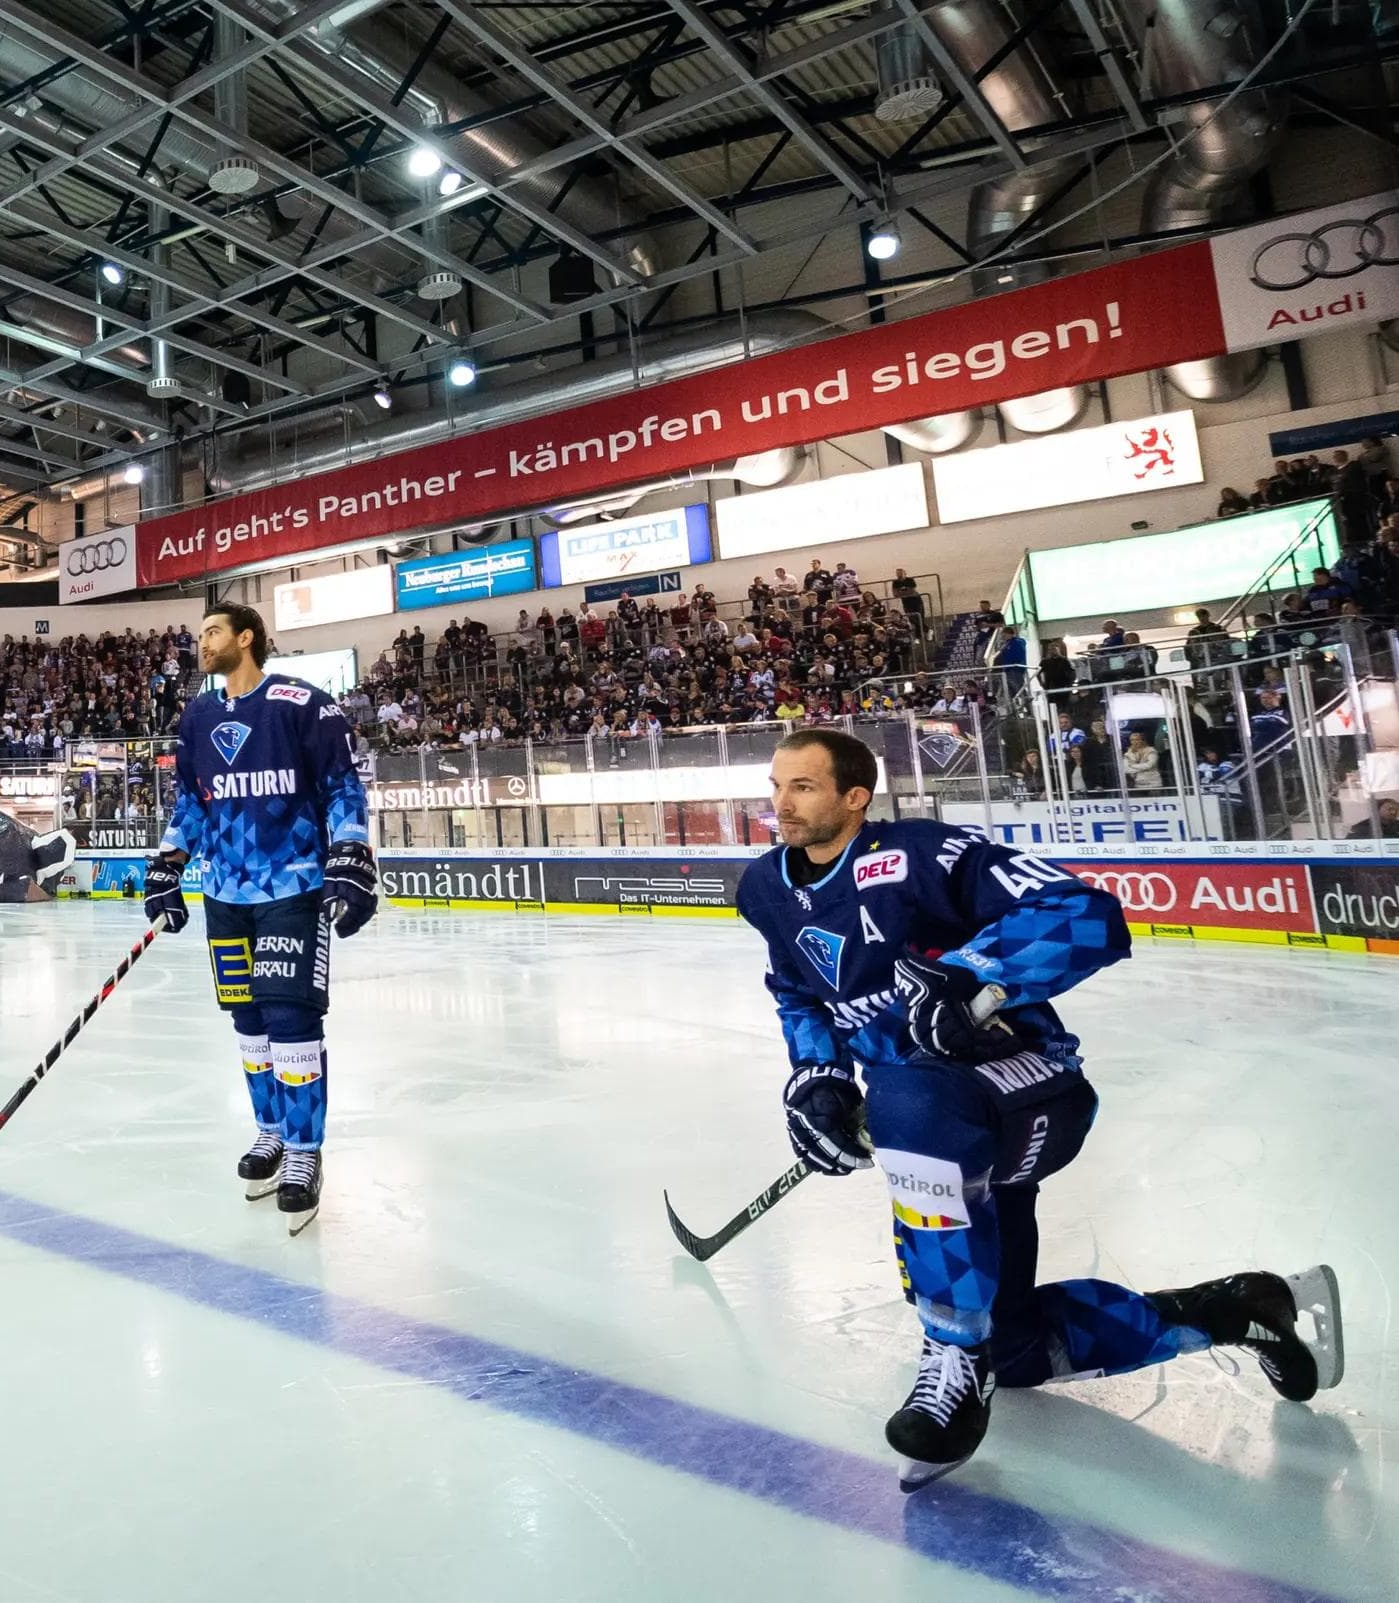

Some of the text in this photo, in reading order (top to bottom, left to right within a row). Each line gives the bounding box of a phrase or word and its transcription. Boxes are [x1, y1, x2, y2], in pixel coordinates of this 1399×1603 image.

[1266, 291, 1369, 331] Audi
[157, 530, 204, 562] Auf
[317, 468, 458, 523] Panther
[508, 405, 721, 478] kämpfen
[742, 368, 850, 425] und
[872, 302, 1123, 394] siegen!
[69, 581, 94, 595] Audi
[663, 575, 678, 590] N
[36, 621, 48, 632] M
[0, 778, 54, 796] SATURN
[213, 769, 296, 800] SATURN
[89, 829, 147, 848] SATURN
[1102, 846, 1125, 855] Audi
[1163, 846, 1186, 855] Audi
[989, 853, 1073, 899] 40
[620, 894, 727, 906] Das IT-Unternehmen.
[1191, 877, 1299, 914] Audi
[1323, 884, 1399, 929] druc
[859, 905, 885, 944] A
[254, 961, 297, 978] BRÄU
